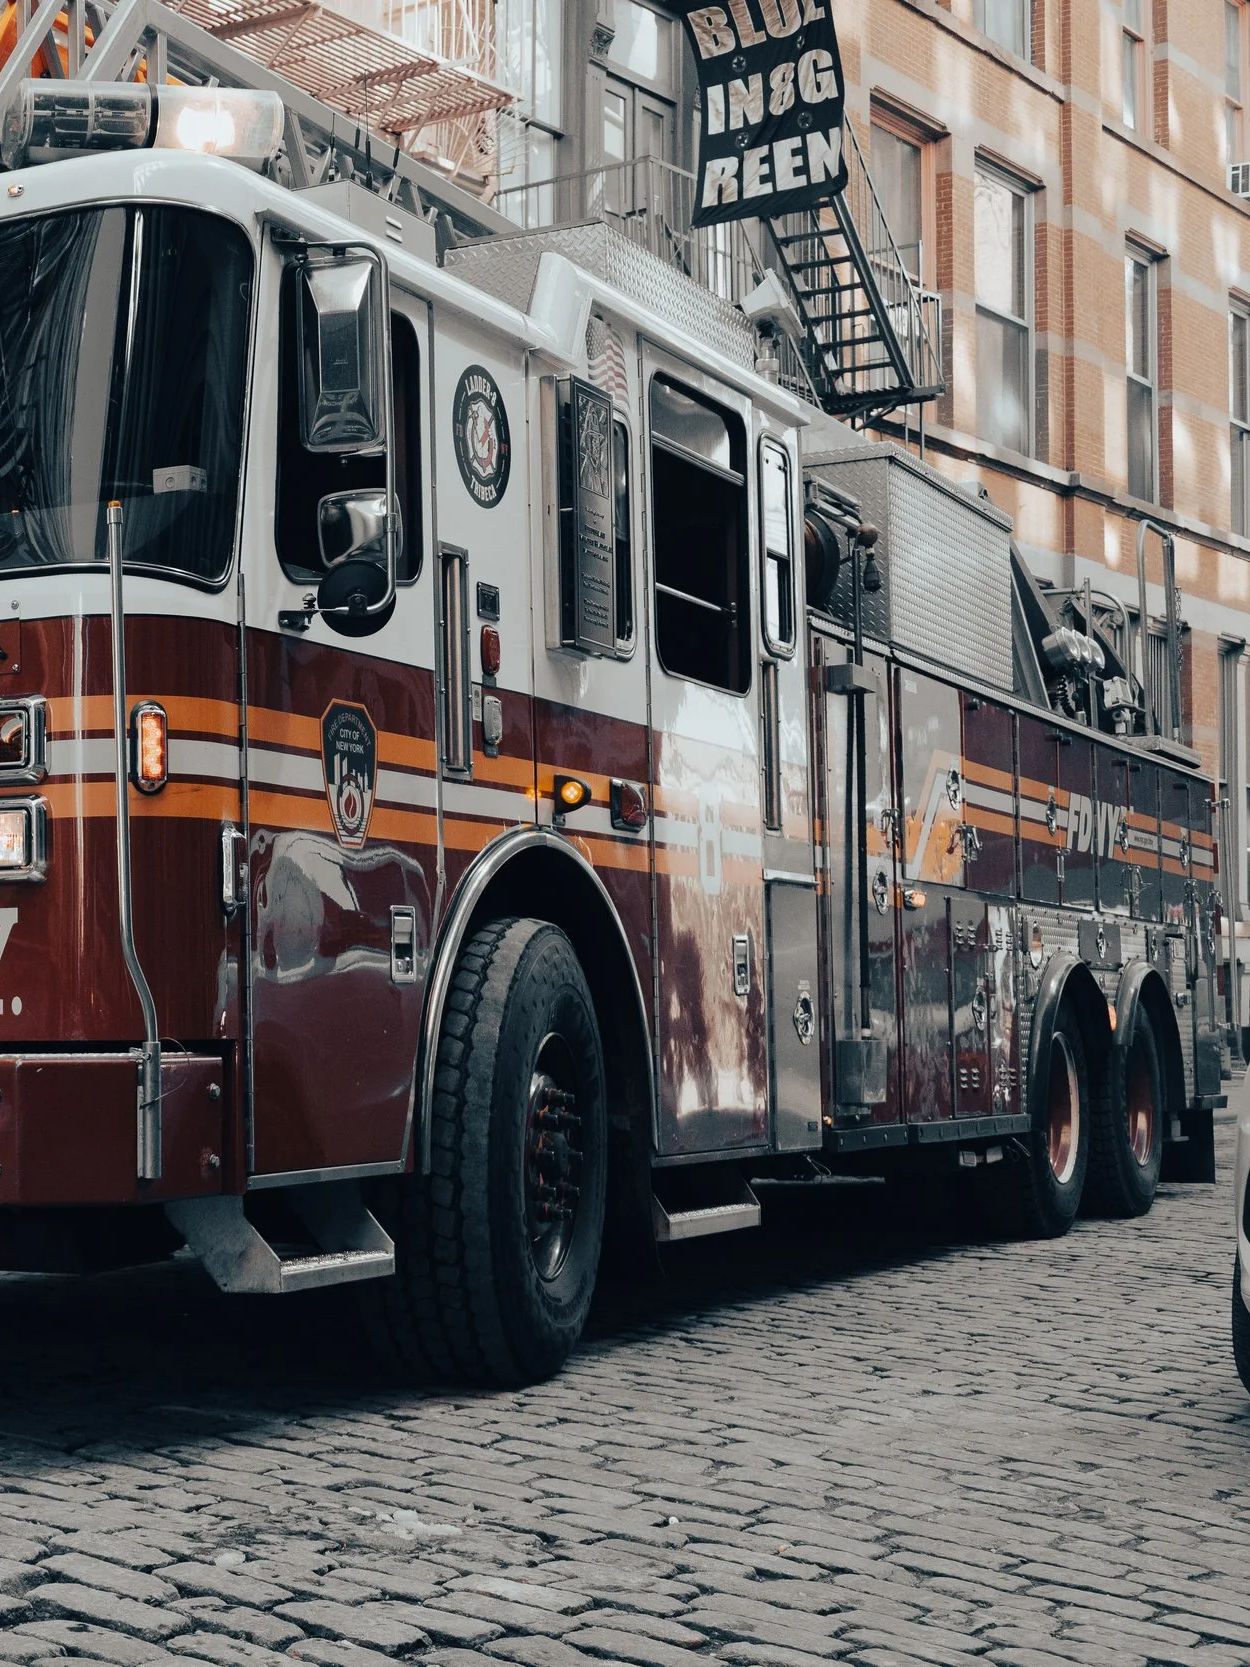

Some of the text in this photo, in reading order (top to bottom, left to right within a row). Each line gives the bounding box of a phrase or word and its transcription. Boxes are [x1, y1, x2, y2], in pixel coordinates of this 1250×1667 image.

[702, 127, 841, 208] REEN
[328, 712, 371, 746] FIRE DEPARTMENT
[340, 728, 360, 741] CITY OF
[336, 740, 364, 755] NEW YORK
